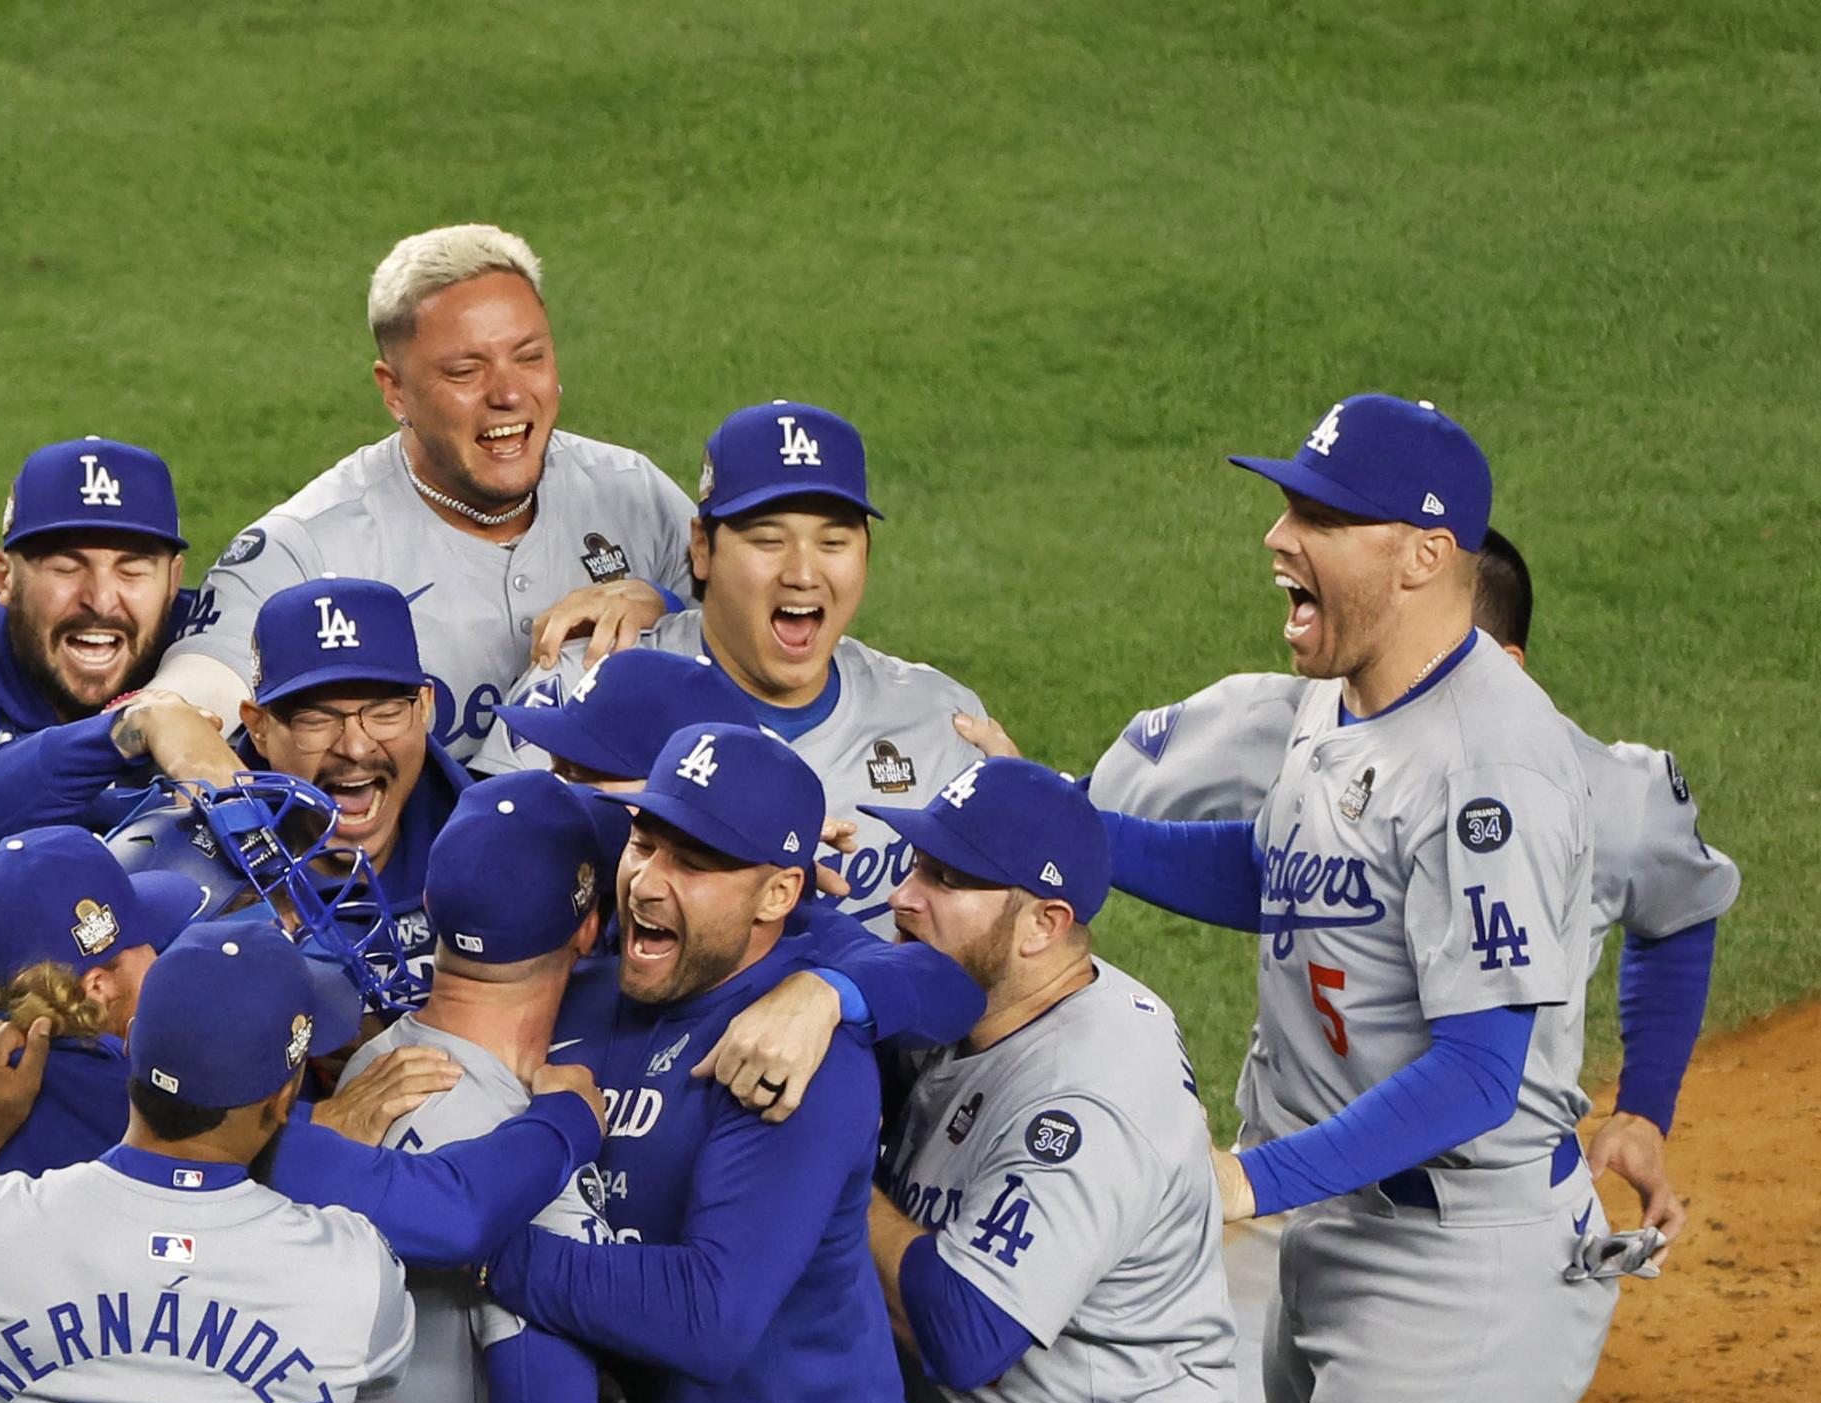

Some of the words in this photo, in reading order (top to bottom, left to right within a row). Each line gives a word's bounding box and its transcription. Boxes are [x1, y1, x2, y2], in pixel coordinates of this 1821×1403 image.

[777, 417, 821, 465] LA
[79, 455, 122, 506] LA
[314, 597, 360, 649] LA
[676, 734, 718, 787] LA
[870, 761, 911, 775] WORLD
[874, 771, 912, 784] SERIES
[941, 760, 986, 809] LA
[1466, 806, 1502, 819] FERNANDO
[1468, 816, 1502, 844] 34
[1463, 885, 1531, 971] LA
[1308, 960, 1349, 1060] 5
[1034, 1126, 1070, 1158] 34
[1040, 1117, 1076, 1135] FERNANDO
[969, 1173, 1035, 1268] LA
